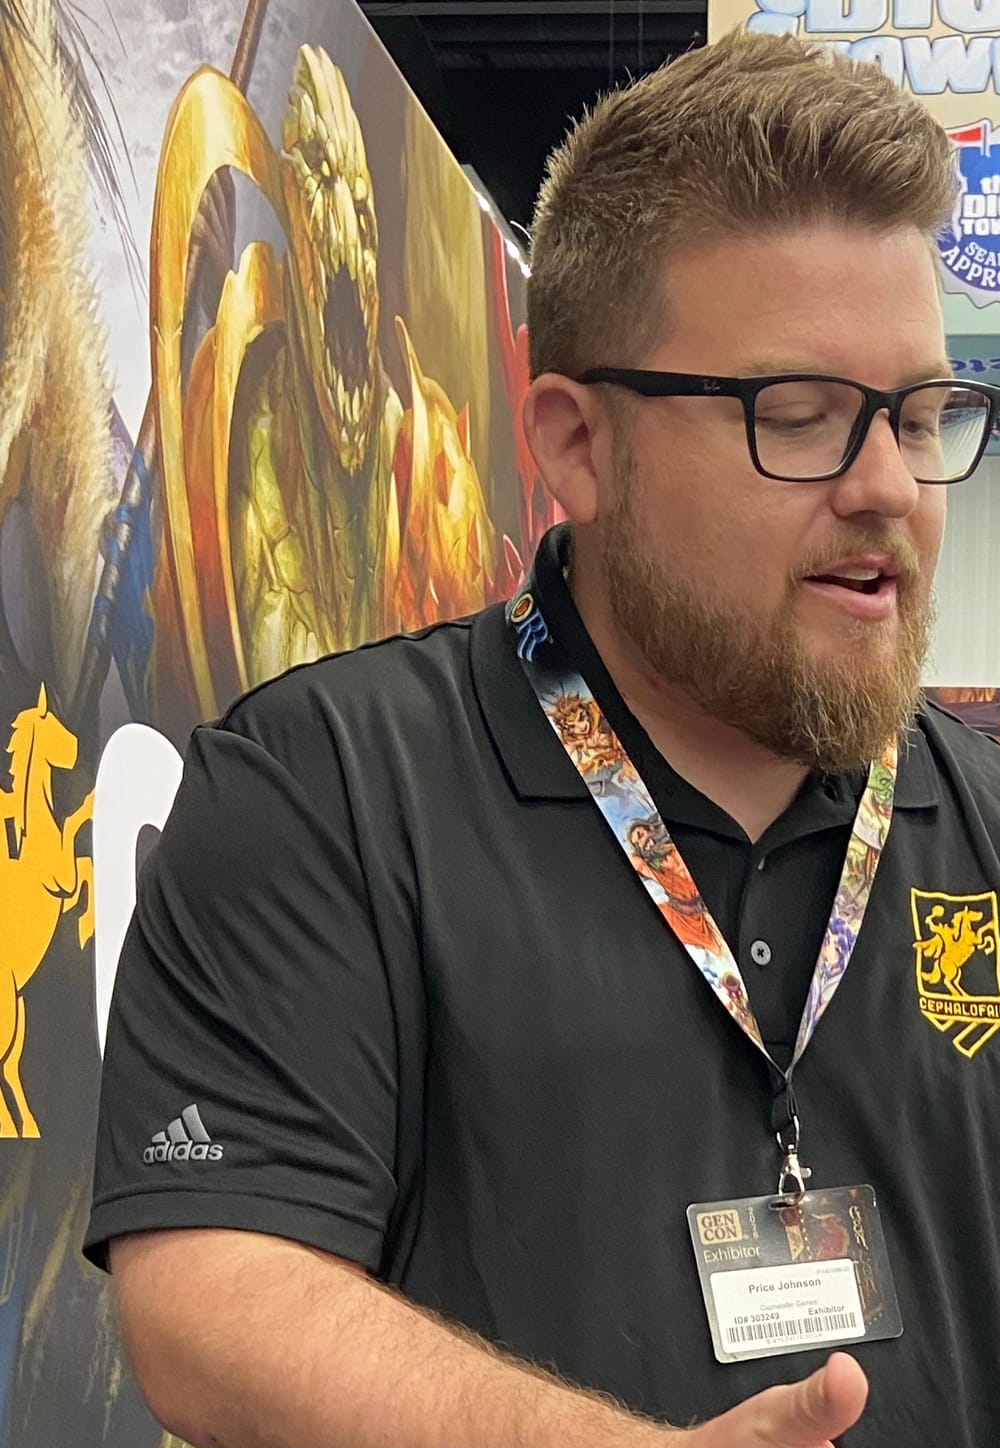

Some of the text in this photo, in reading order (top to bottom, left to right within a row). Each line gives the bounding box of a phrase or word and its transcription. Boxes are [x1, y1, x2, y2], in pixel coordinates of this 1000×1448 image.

[143, 1139, 223, 1164] adidas
[701, 1213, 735, 1228] GEN
[704, 1226, 737, 1241] CON
[703, 1246, 761, 1263] Exhibitor
[749, 1278, 822, 1294] Price Johnson
[808, 1305, 845, 1316] Exhibitor
